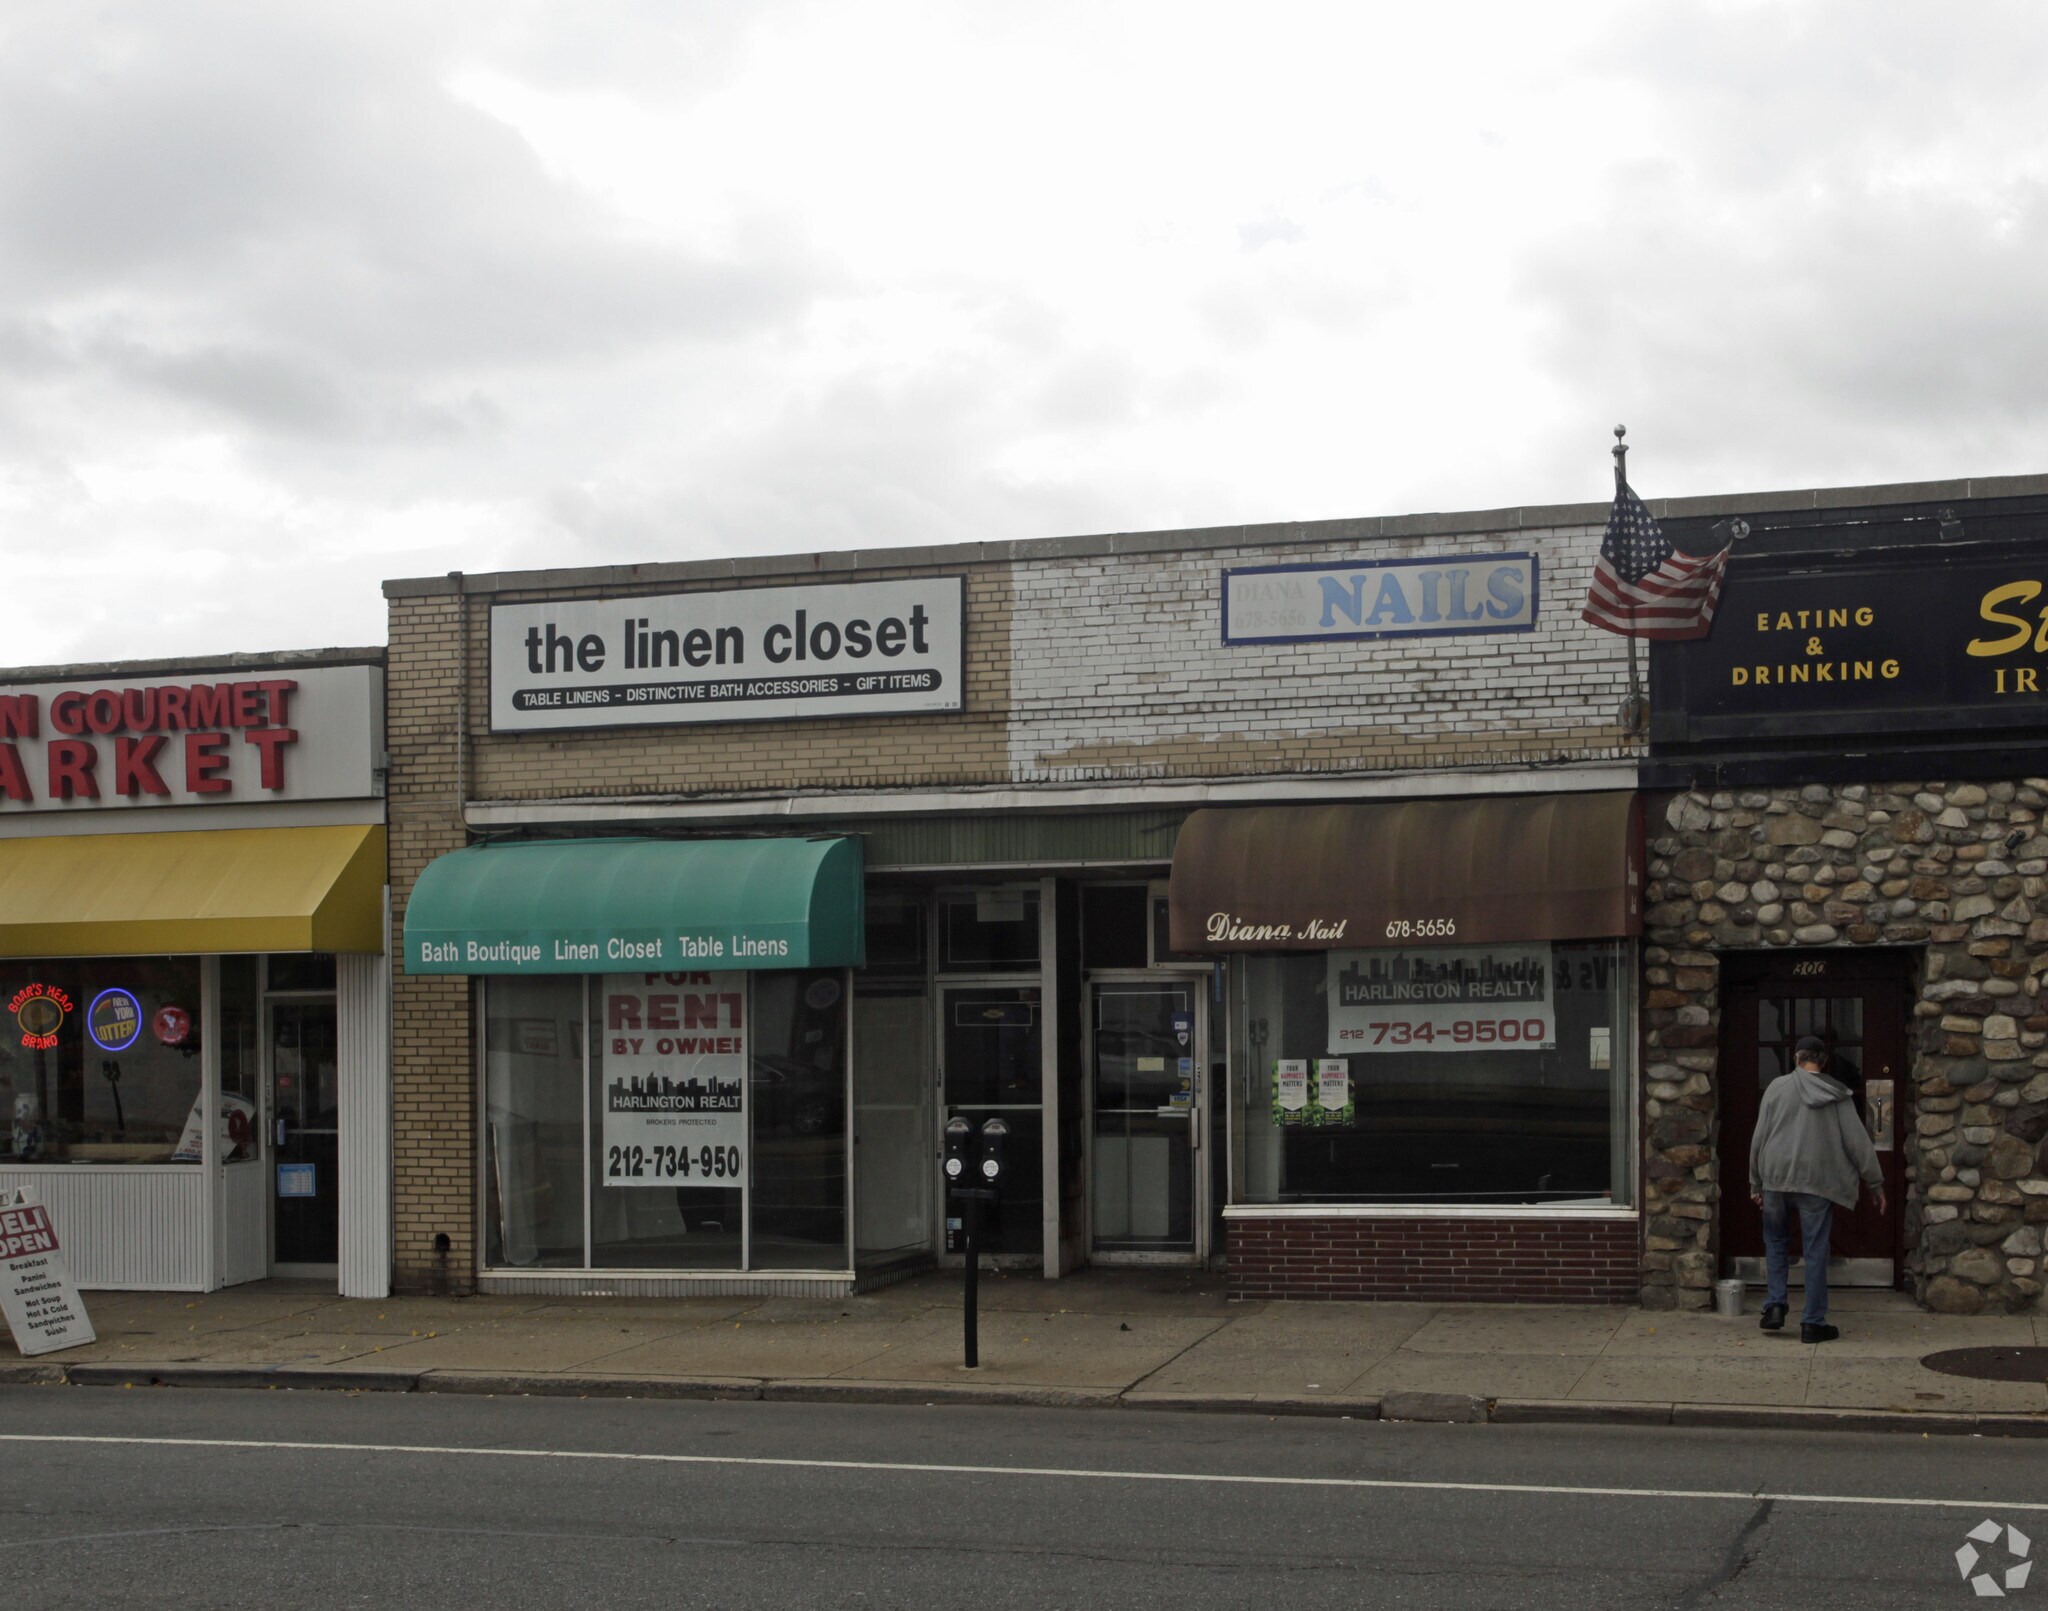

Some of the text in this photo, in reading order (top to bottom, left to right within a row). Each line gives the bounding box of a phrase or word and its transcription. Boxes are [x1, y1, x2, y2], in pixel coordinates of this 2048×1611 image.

[1235, 580, 1305, 603] DIANA
[1317, 566, 1525, 627] NAILS
[1235, 608, 1307, 629] 678-5656
[1757, 606, 1874, 632] EATING
[525, 604, 929, 674] the linen closet
[1805, 635, 1824, 656] &
[1732, 658, 1900, 686] DRINKING
[1992, 667, 2048, 695] IR
[522, 691, 562, 707] TABLE
[565, 689, 611, 705] LINENS
[626, 685, 706, 702] DISTINCTIVE
[709, 682, 744, 699] BATH
[746, 678, 839, 697] ACCESSORIES
[856, 675, 887, 691] GIFT
[889, 673, 932, 689] ITEMS
[50, 679, 298, 735] GOURMET
[1206, 912, 1456, 941] Diana Nail 678-5656
[421, 935, 788, 965] Bath Boutique Linen Closet Table Linens
[8, 983, 75, 1013] BOAR'S HEAD
[1344, 979, 1538, 1001] HARLINGTON REALTY
[112, 997, 130, 1006] NEW
[608, 993, 742, 1030] RENT
[114, 1007, 135, 1021] YORK
[95, 1020, 136, 1041] LOTTERY
[1339, 1018, 1545, 1045] 212 734-9500
[21, 1033, 59, 1050] BRAND
[612, 1038, 644, 1055] BY
[613, 1095, 742, 1109] HARLINGTON REALT
[646, 1118, 717, 1126] BROKERS PROTECTED
[609, 1145, 742, 1178] 212-734-950
[10, 1258, 48, 1271] Breakfast
[21, 1272, 47, 1283] Panini
[14, 1281, 62, 1296] Sandwiches
[25, 1295, 61, 1308] Hot Soup
[26, 1304, 68, 1319] Hot & Cold
[28, 1314, 75, 1330] Sandwiches
[45, 1326, 67, 1337] Sushi
